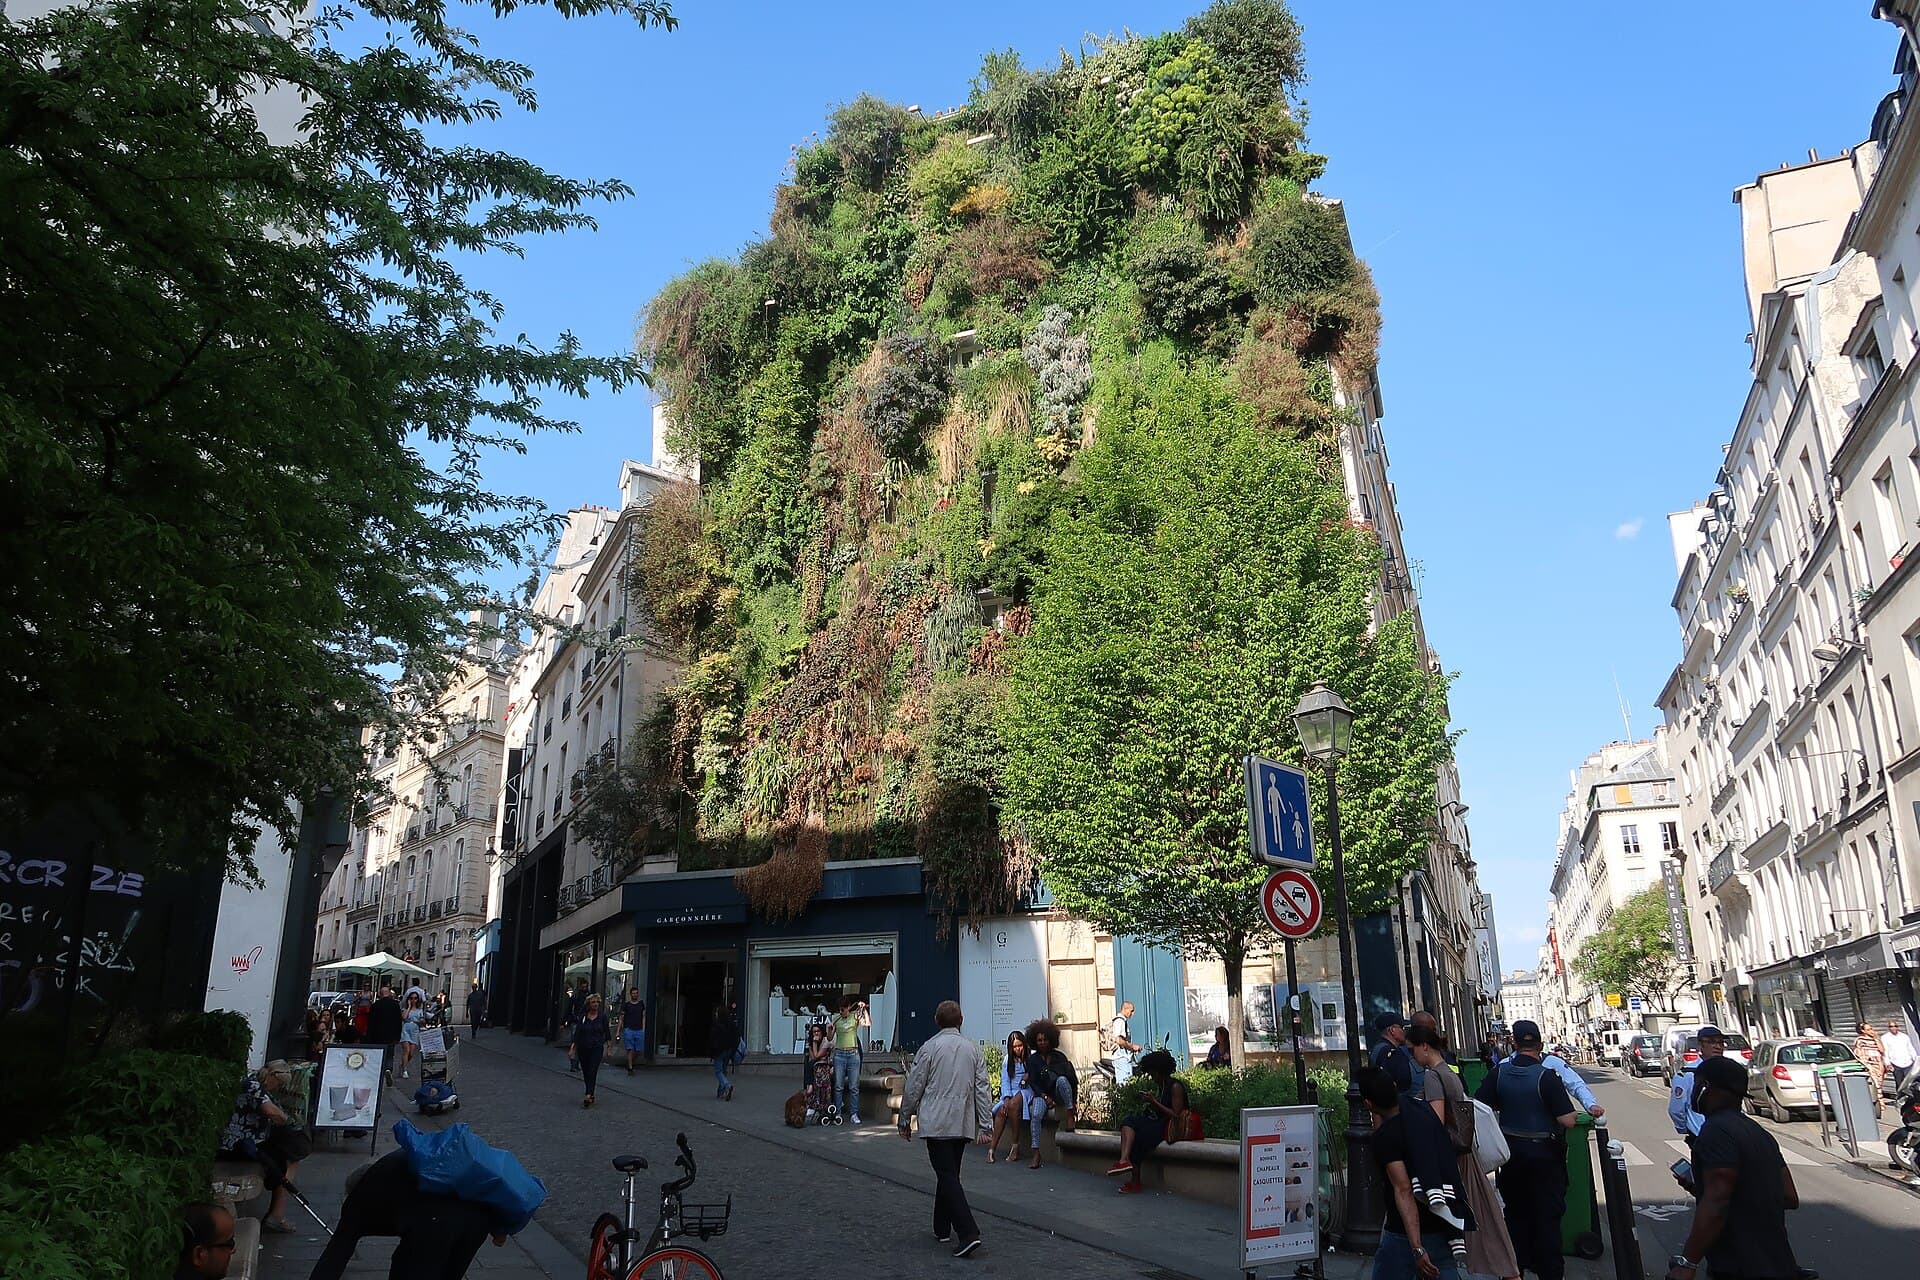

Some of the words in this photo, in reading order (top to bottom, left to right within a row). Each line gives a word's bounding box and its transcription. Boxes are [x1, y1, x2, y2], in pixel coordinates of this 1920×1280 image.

[1664, 862, 1677, 899] SHINE
[1672, 907, 1688, 960] BLOSSOM
[996, 932, 1007, 945] G
[806, 1016, 831, 1026] VEJA
[1256, 1165, 1280, 1173] CHAPEAUX
[1253, 1176, 1284, 1186] CASQUETTES
